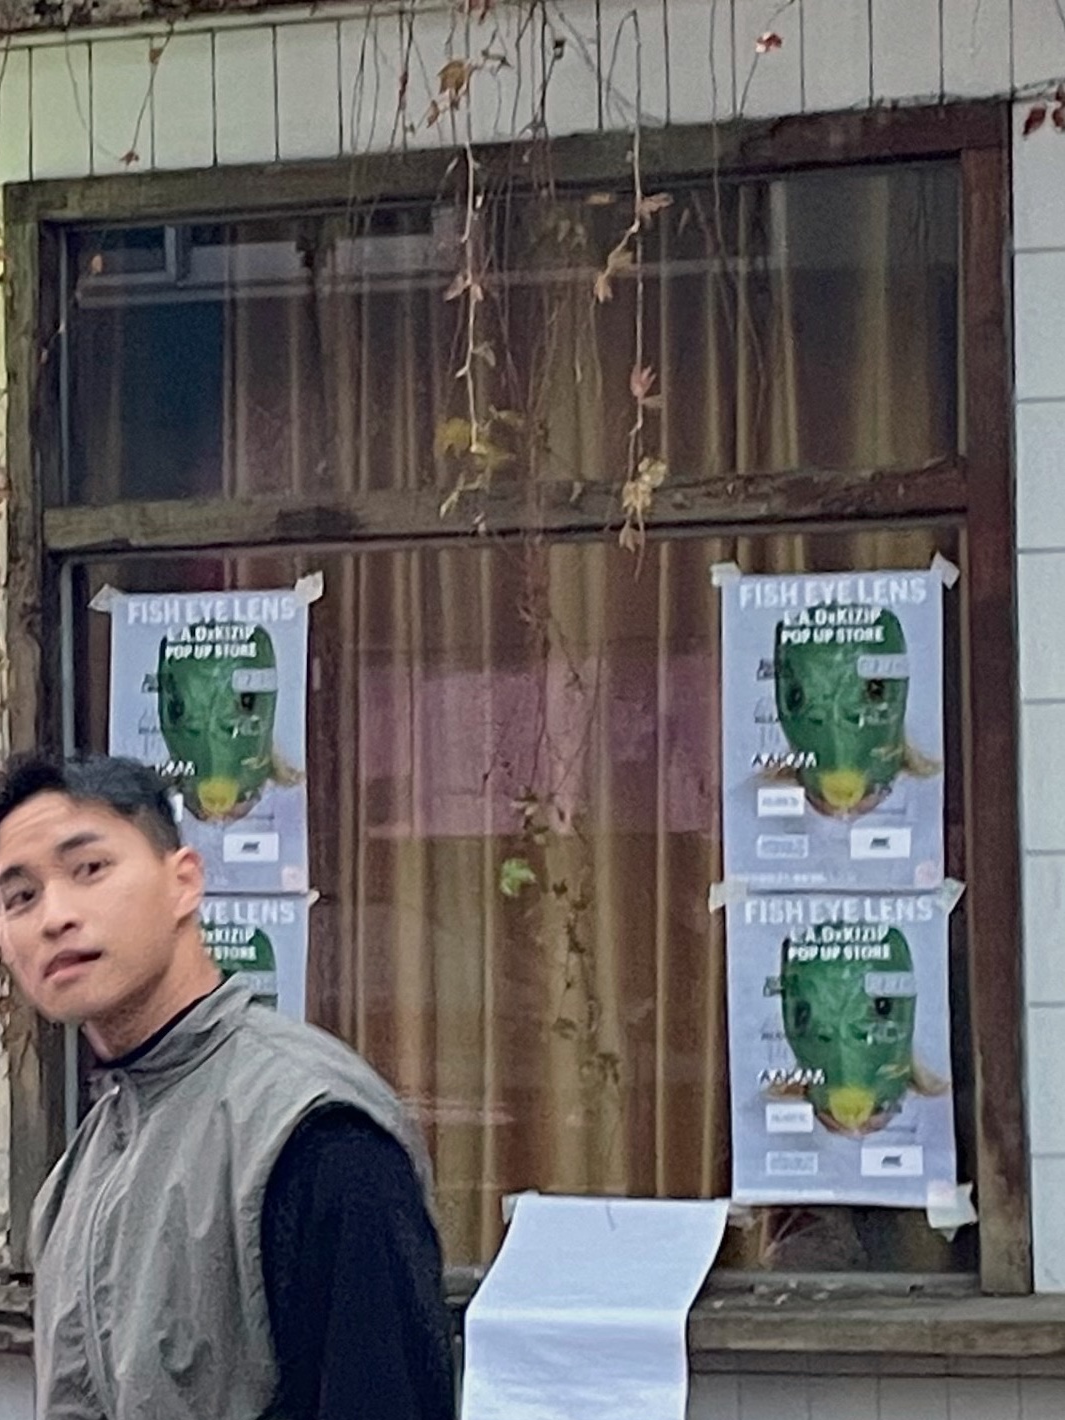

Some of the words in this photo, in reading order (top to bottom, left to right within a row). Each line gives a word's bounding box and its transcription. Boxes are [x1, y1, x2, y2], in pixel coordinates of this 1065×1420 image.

[740, 580, 798, 609] FISH
[804, 579, 853, 606] EYE
[857, 576, 927, 606] LENS
[127, 599, 180, 625] FISH
[185, 598, 230, 625] EYE
[234, 596, 296, 622] LENS
[200, 900, 230, 925] YE
[234, 899, 295, 924] LENS
[744, 898, 804, 924] FISH
[809, 898, 859, 924] EYE
[864, 896, 933, 923] LENS
